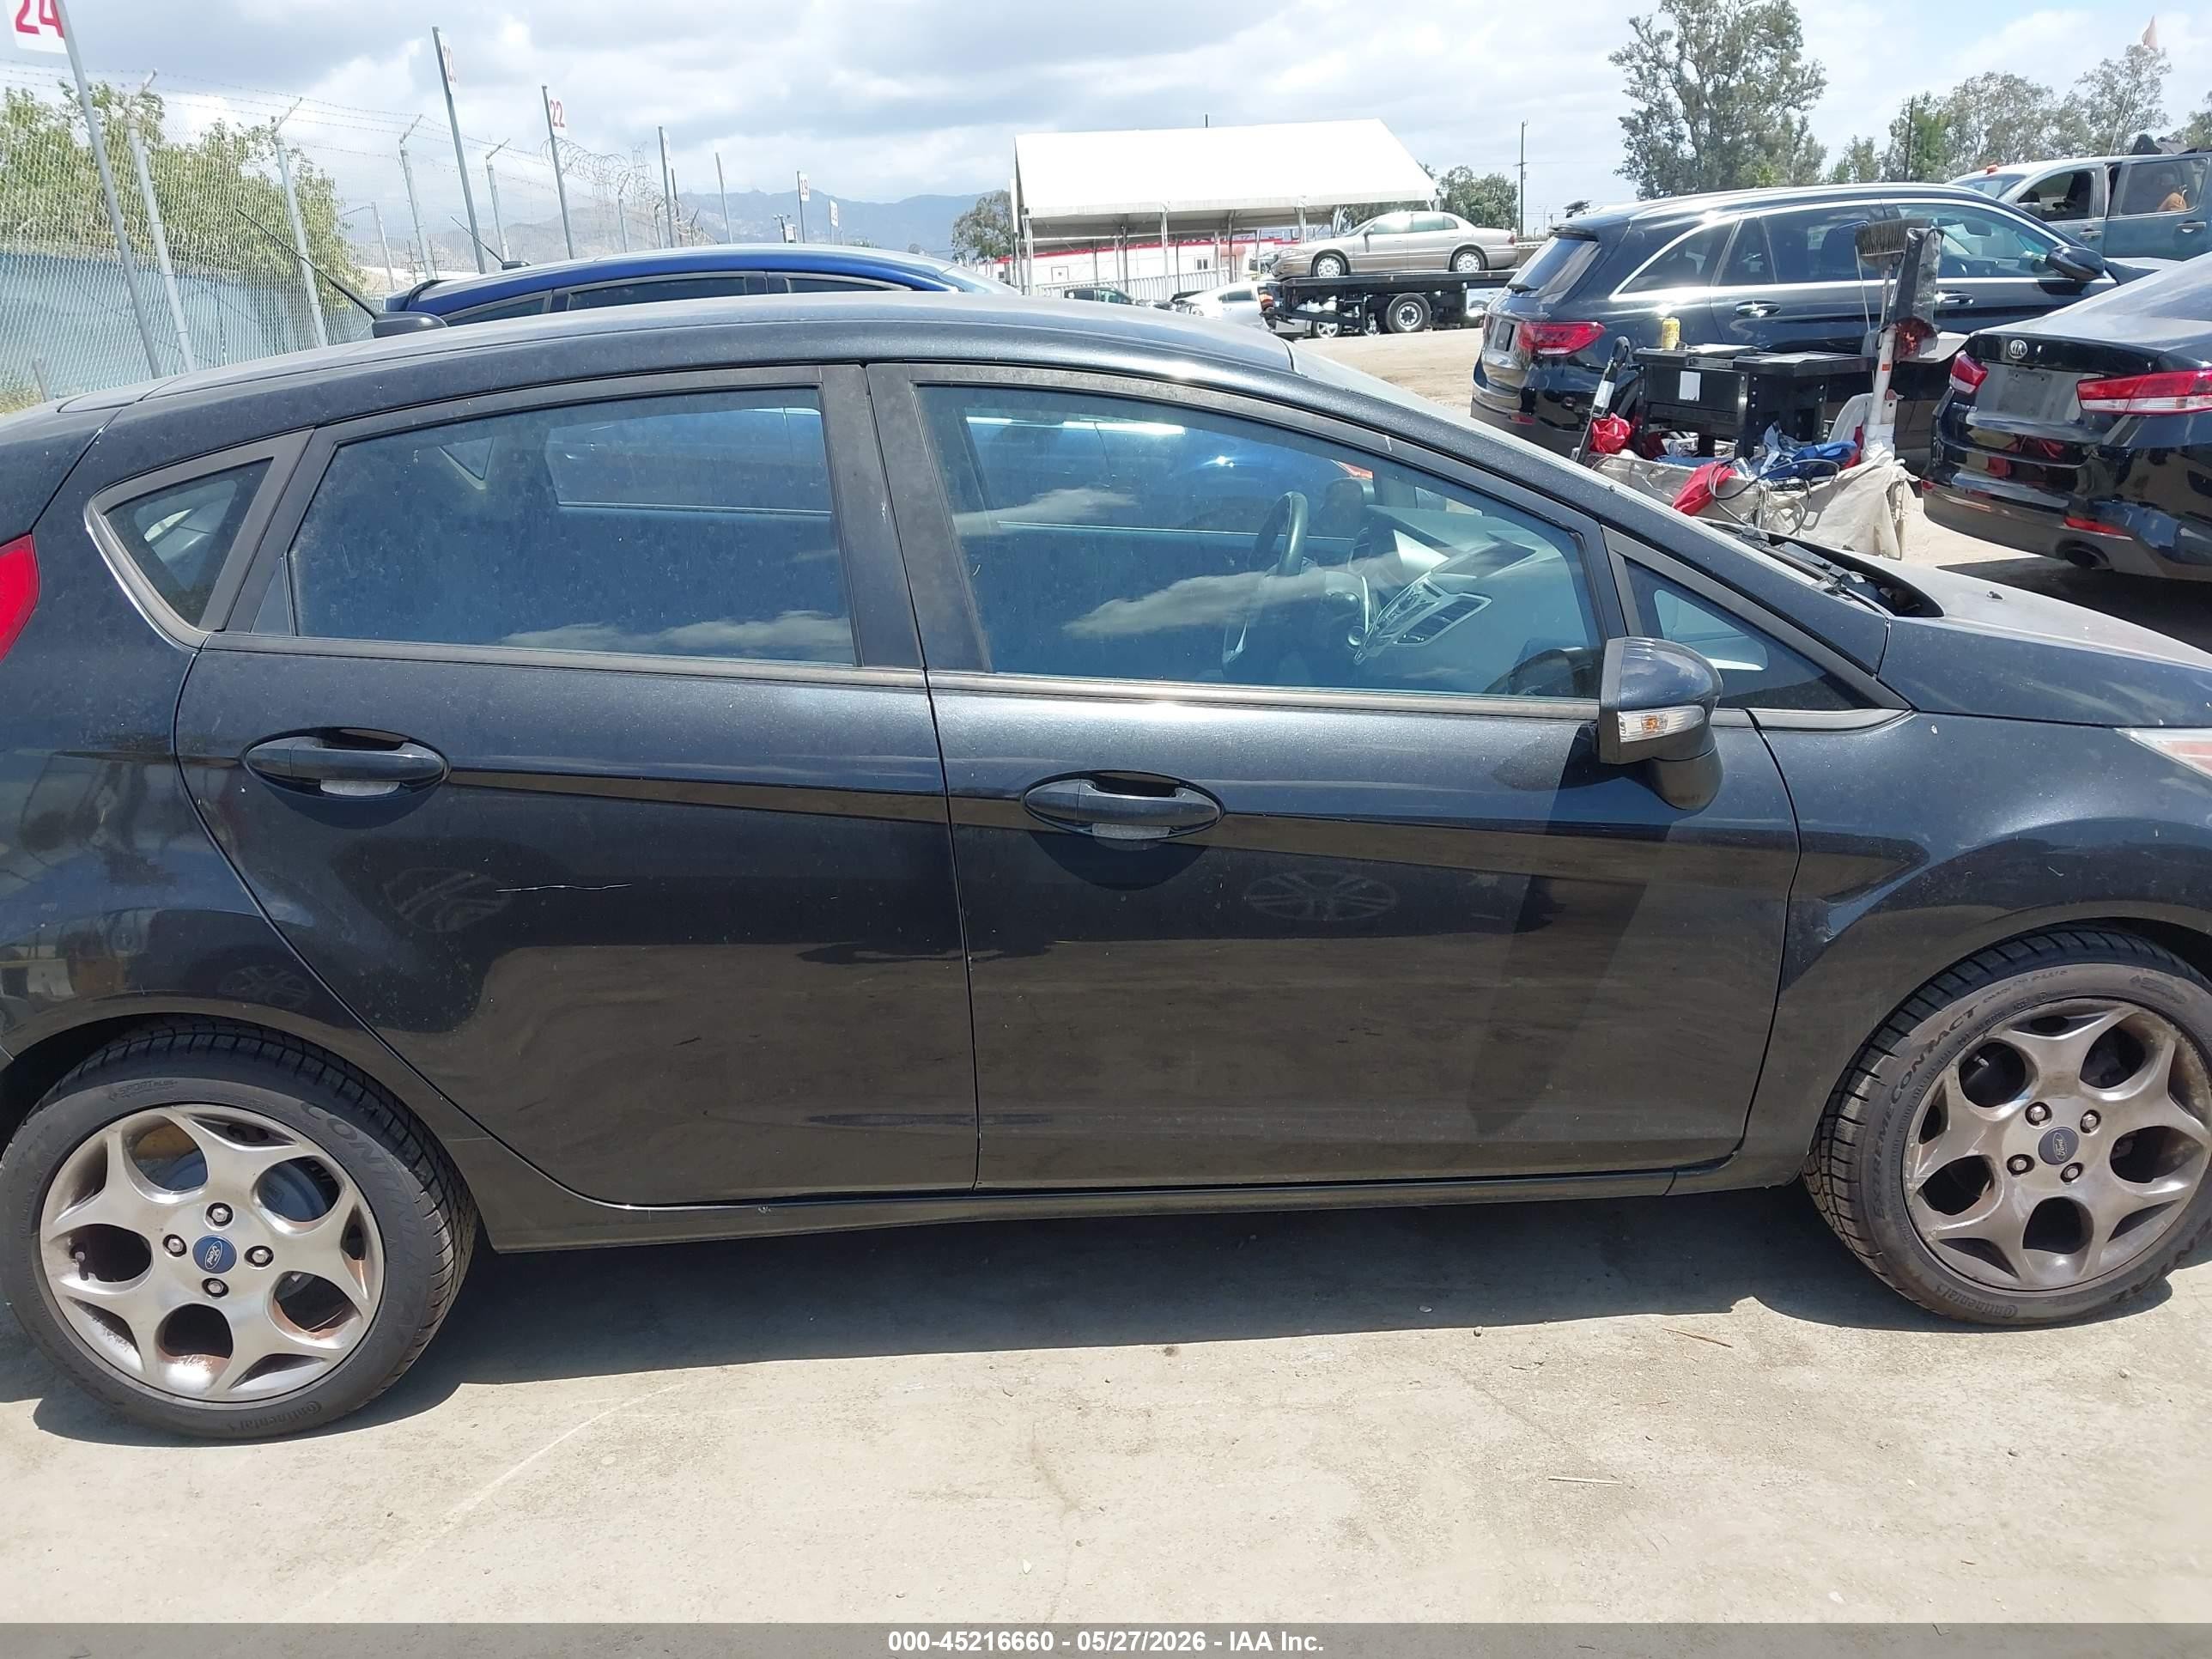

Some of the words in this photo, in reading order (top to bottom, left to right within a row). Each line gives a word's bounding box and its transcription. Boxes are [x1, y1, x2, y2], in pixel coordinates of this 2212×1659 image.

[550, 100, 565, 127] 22
[2054, 1137, 2067, 1158] Ford
[206, 1244, 222, 1267] Ford
[240, 1401, 322, 1431] Continental
